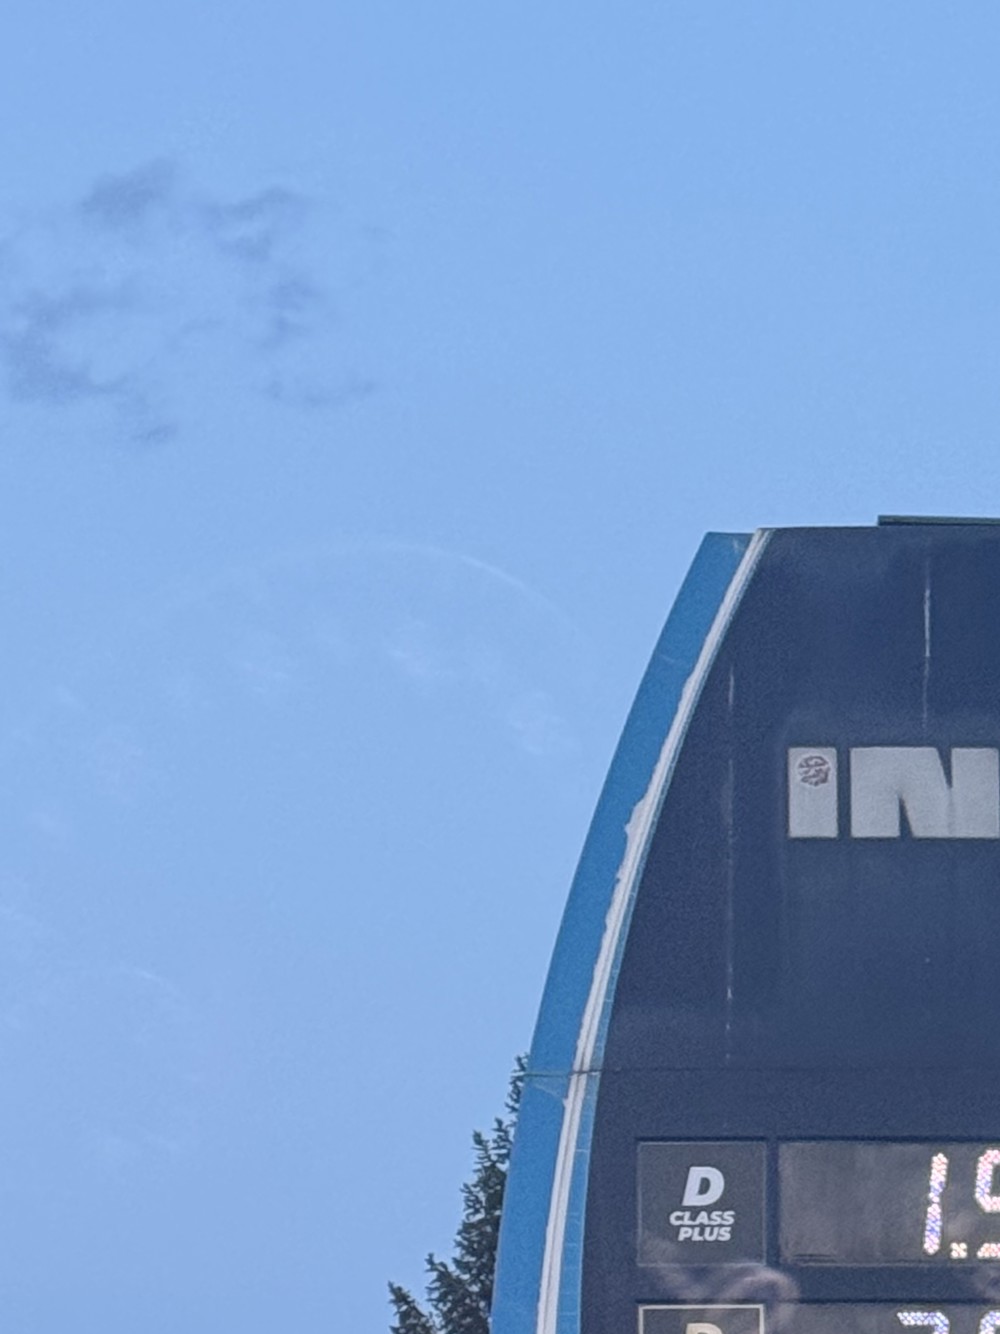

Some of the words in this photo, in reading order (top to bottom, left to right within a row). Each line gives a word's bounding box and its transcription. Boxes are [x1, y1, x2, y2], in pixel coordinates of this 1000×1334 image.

[682, 1166, 725, 1206] D
[669, 1211, 735, 1225] CLASS
[678, 1227, 731, 1241] PLUS
